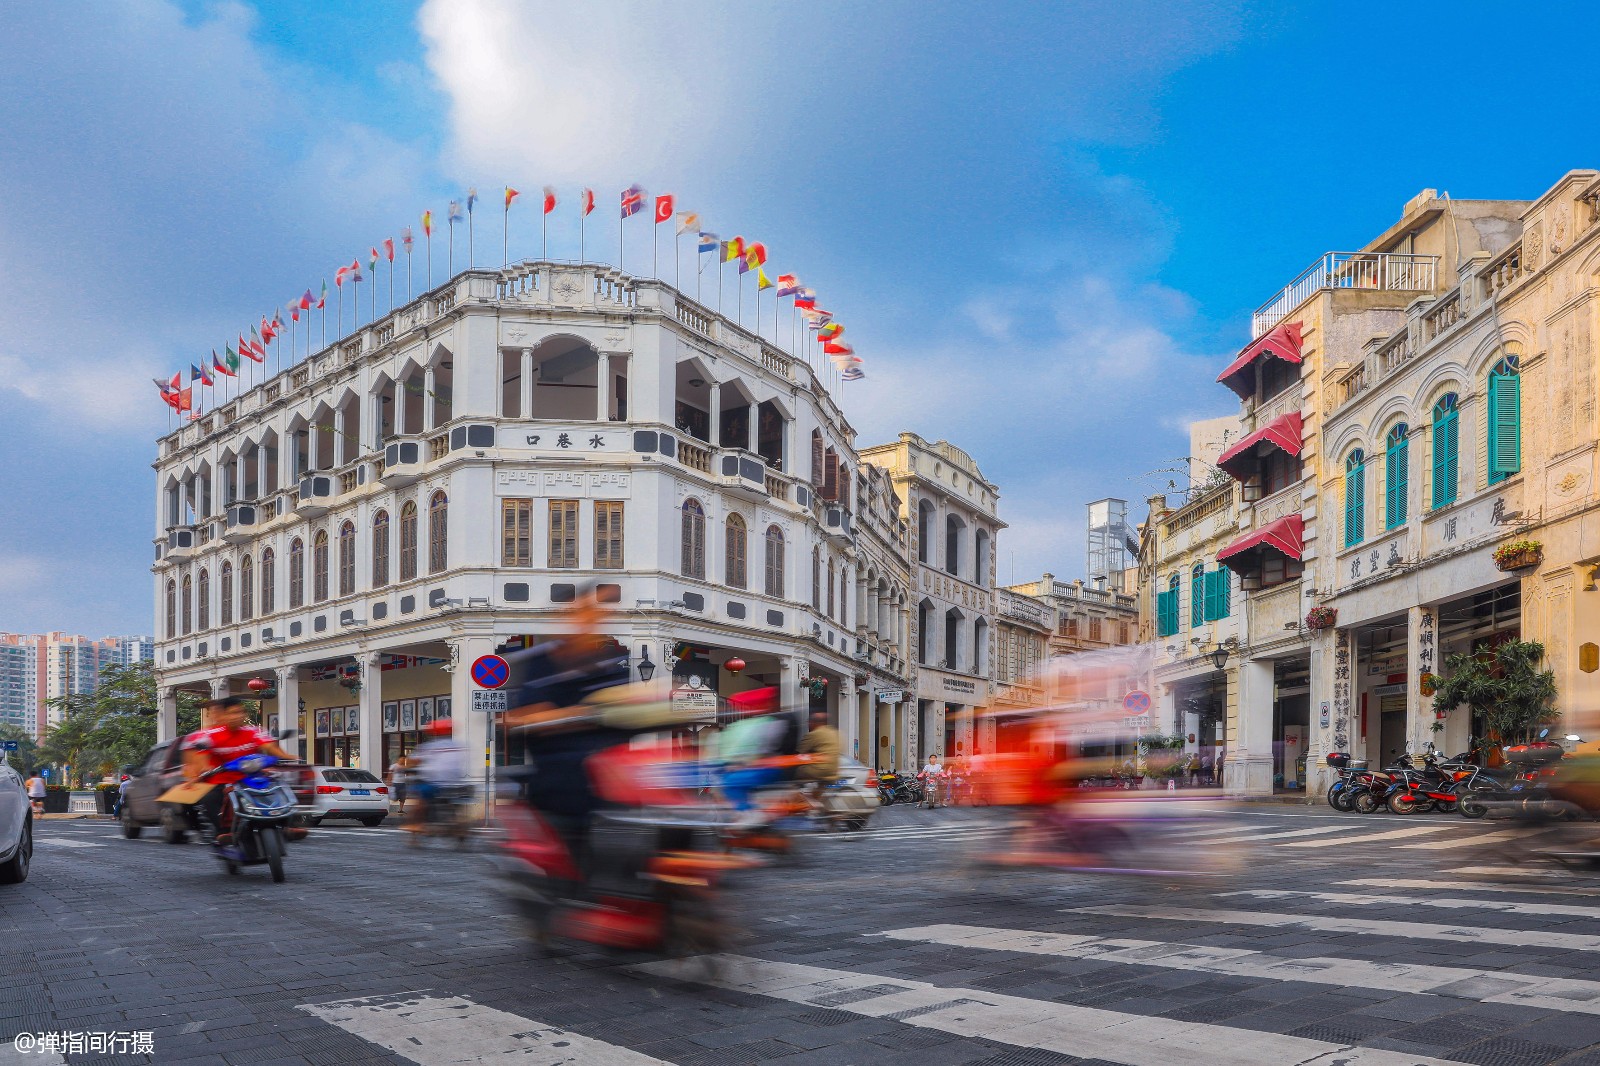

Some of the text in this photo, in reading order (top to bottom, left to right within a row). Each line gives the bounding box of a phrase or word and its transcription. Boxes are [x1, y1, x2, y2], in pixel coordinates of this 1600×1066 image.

[474, 692, 505, 700] 禁止停车
[474, 702, 505, 710] 违停抓拍
